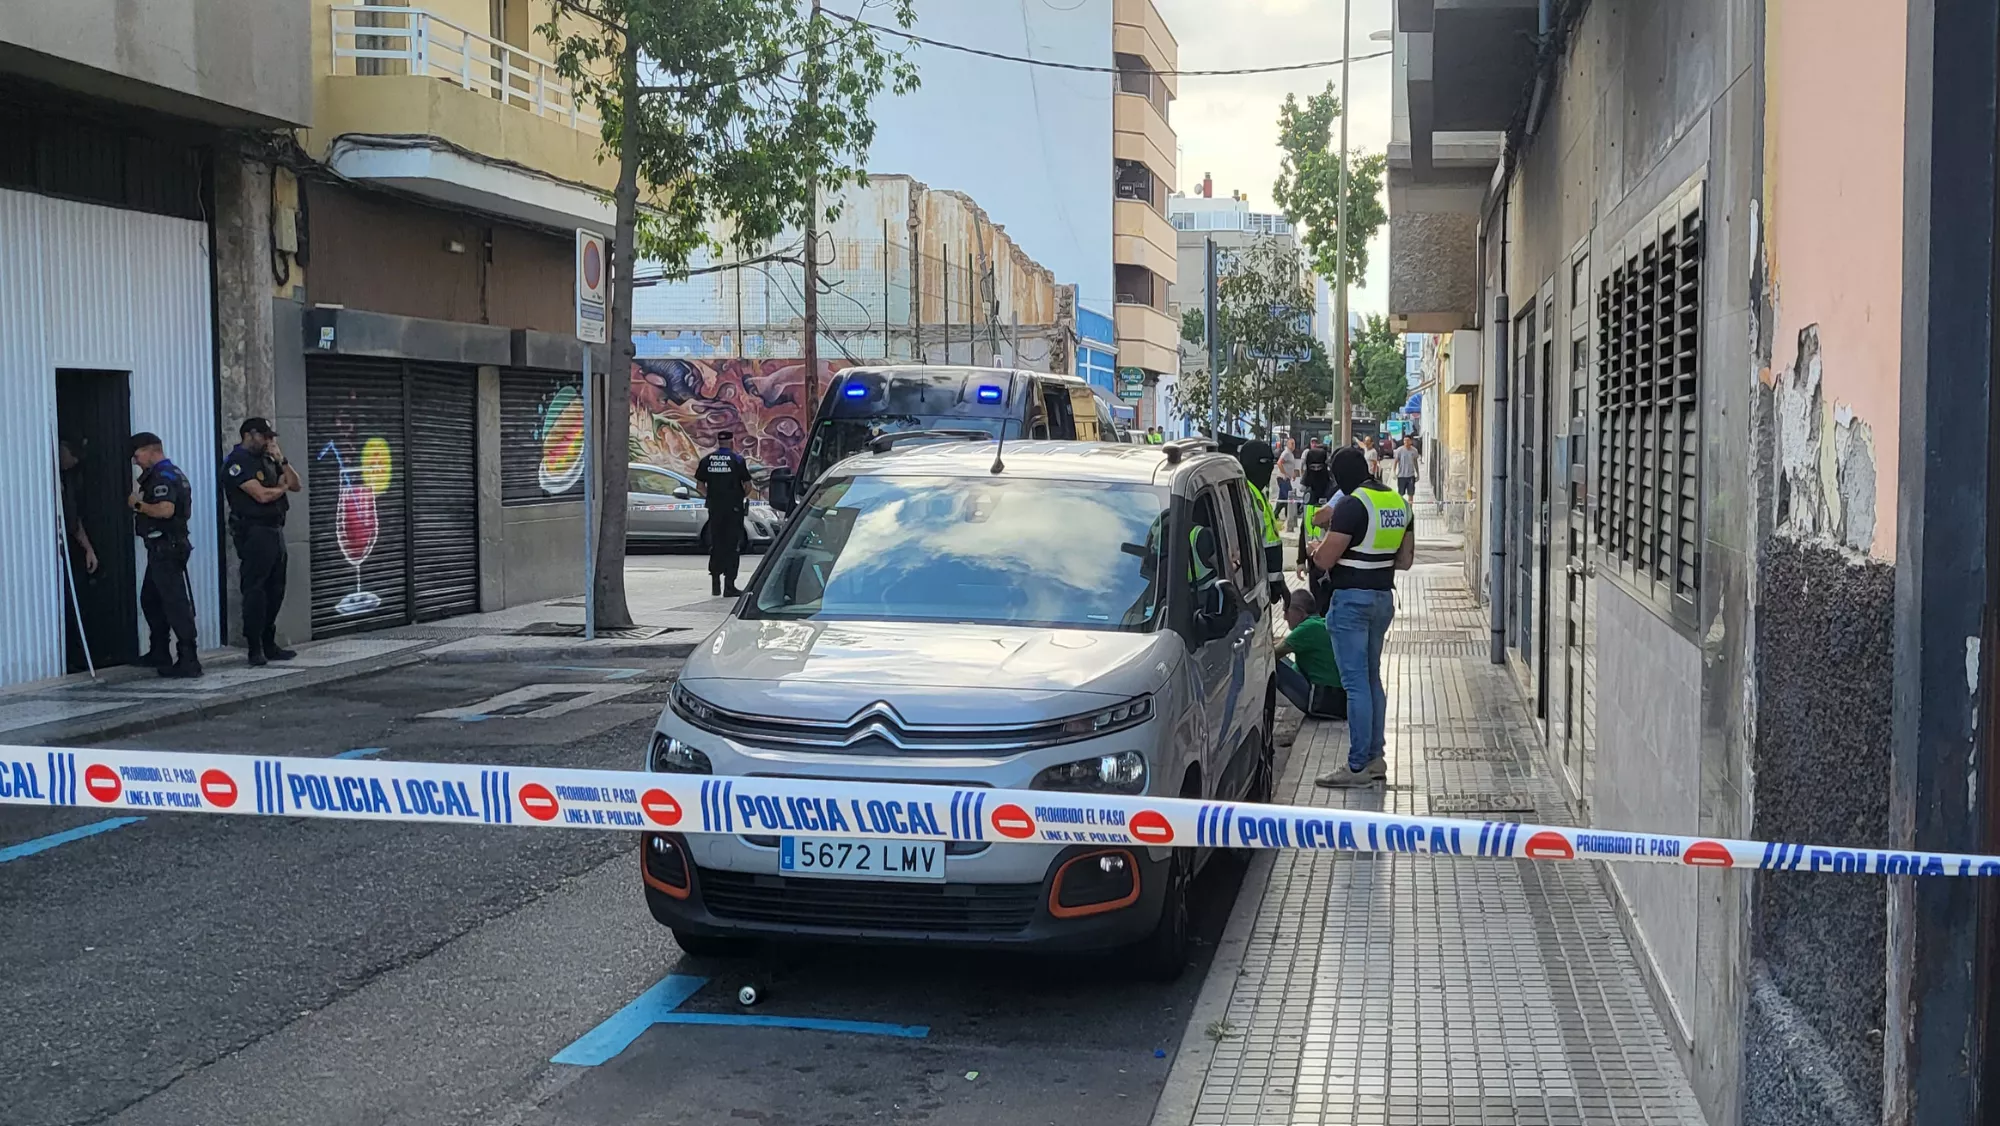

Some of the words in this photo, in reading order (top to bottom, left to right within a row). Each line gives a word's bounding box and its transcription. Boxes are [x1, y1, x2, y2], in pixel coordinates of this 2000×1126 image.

[1381, 518, 1404, 528] LOCAL
[119, 766, 162, 783] PROHIBIDO
[163, 768, 174, 783] EL
[175, 768, 197, 784] PASO
[125, 790, 152, 806] LINEA
[152, 791, 166, 807] DE
[166, 792, 203, 808] POLICIA
[287, 773, 392, 814] POLICIA
[392, 778, 480, 817] LOCAL
[555, 785, 601, 802] PROHIBIDO
[602, 788, 613, 803] EL
[613, 788, 637, 804] PASO
[563, 808, 592, 824] LINEA
[592, 810, 606, 825] DE
[606, 810, 645, 826] POLICIA
[735, 794, 851, 833] POLICIA
[851, 799, 948, 836] LOCAL
[1034, 806, 1084, 824] PROHIBIDO
[1086, 809, 1098, 825] EL
[1099, 809, 1125, 826] PASO
[1040, 830, 1072, 842] LINEA
[1073, 832, 1089, 842] DE
[1089, 832, 1132, 843] POLICIA
[1237, 815, 1359, 851] POLICIA
[1368, 822, 1463, 856] LOCAL
[1576, 834, 1632, 855] PROHIBIDO
[1635, 837, 1648, 856] EL
[1650, 839, 1680, 858] PASO
[784, 856, 791, 864] E
[801, 841, 871, 870] 5672
[883, 845, 936, 873] LMV
